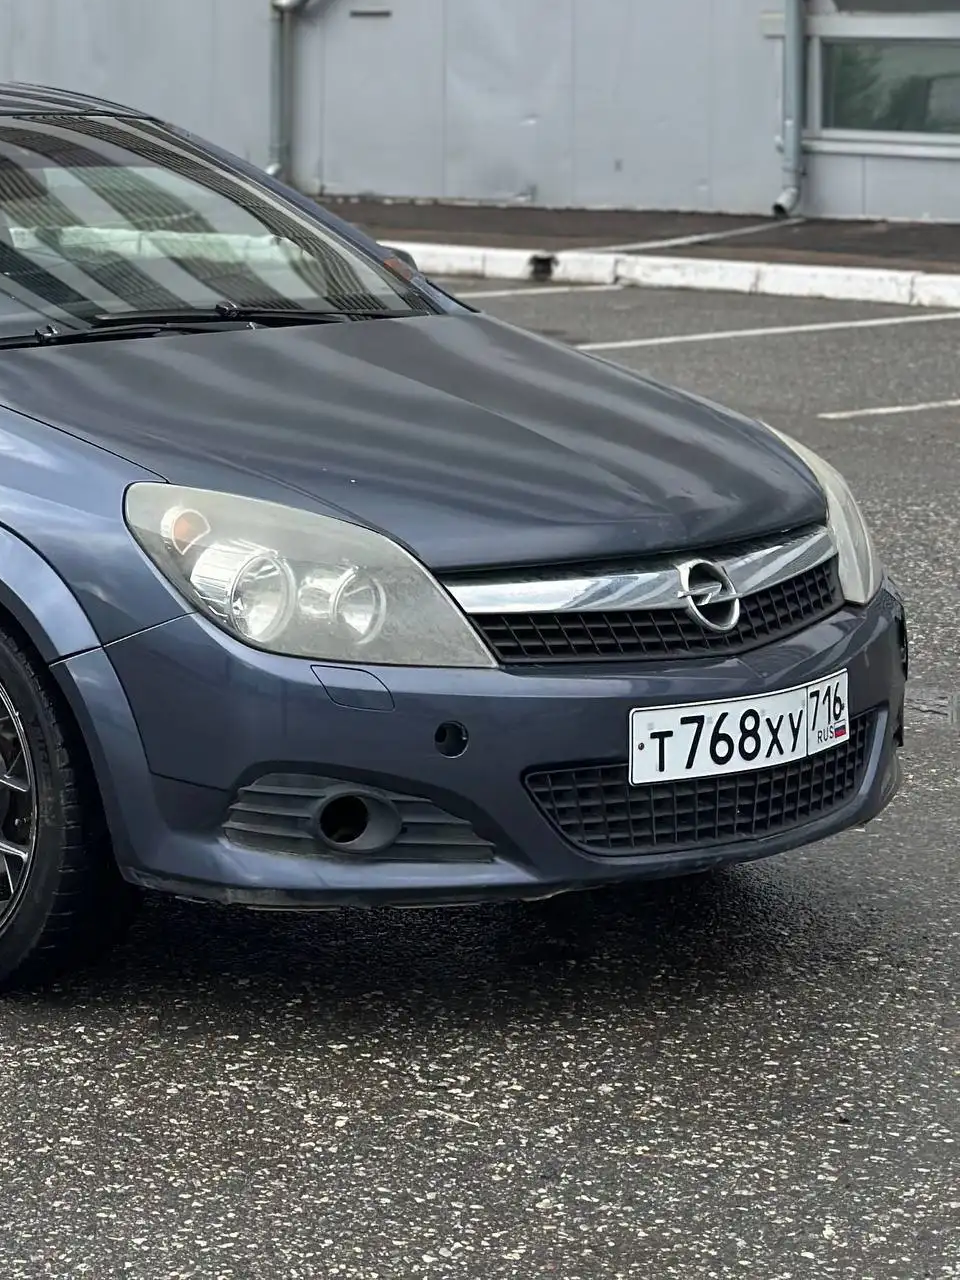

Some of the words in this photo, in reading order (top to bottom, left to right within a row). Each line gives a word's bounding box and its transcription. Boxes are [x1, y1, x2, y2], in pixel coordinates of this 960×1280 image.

[650, 708, 803, 772] Т768ХУ
[809, 681, 842, 731] 716
[817, 724, 835, 744] RUS
